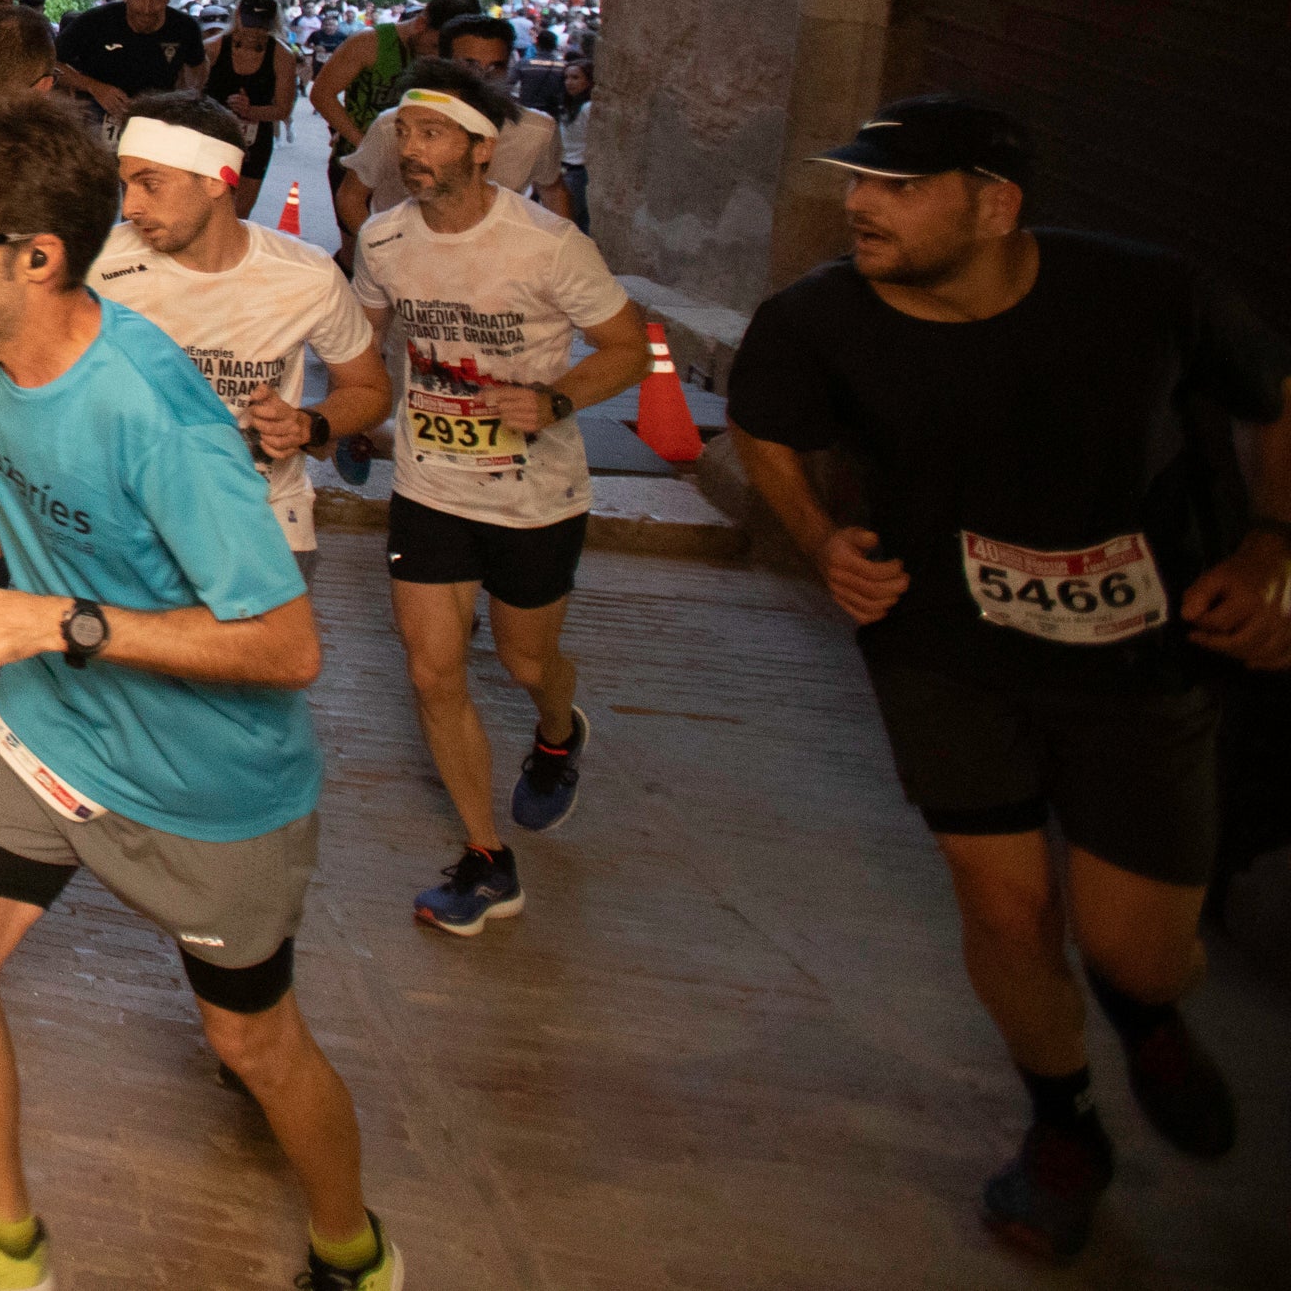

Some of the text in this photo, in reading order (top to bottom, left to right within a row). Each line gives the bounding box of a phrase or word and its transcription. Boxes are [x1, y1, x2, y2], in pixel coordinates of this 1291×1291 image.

[101, 265, 136, 280] luanvi
[414, 299, 473, 311] TotalEnergies
[415, 309, 524, 329] MEDIA MARATÓN
[443, 326, 460, 342] DE
[463, 325, 525, 346] GRANADA
[413, 412, 502, 447] 2937
[979, 565, 1136, 614] 5466
